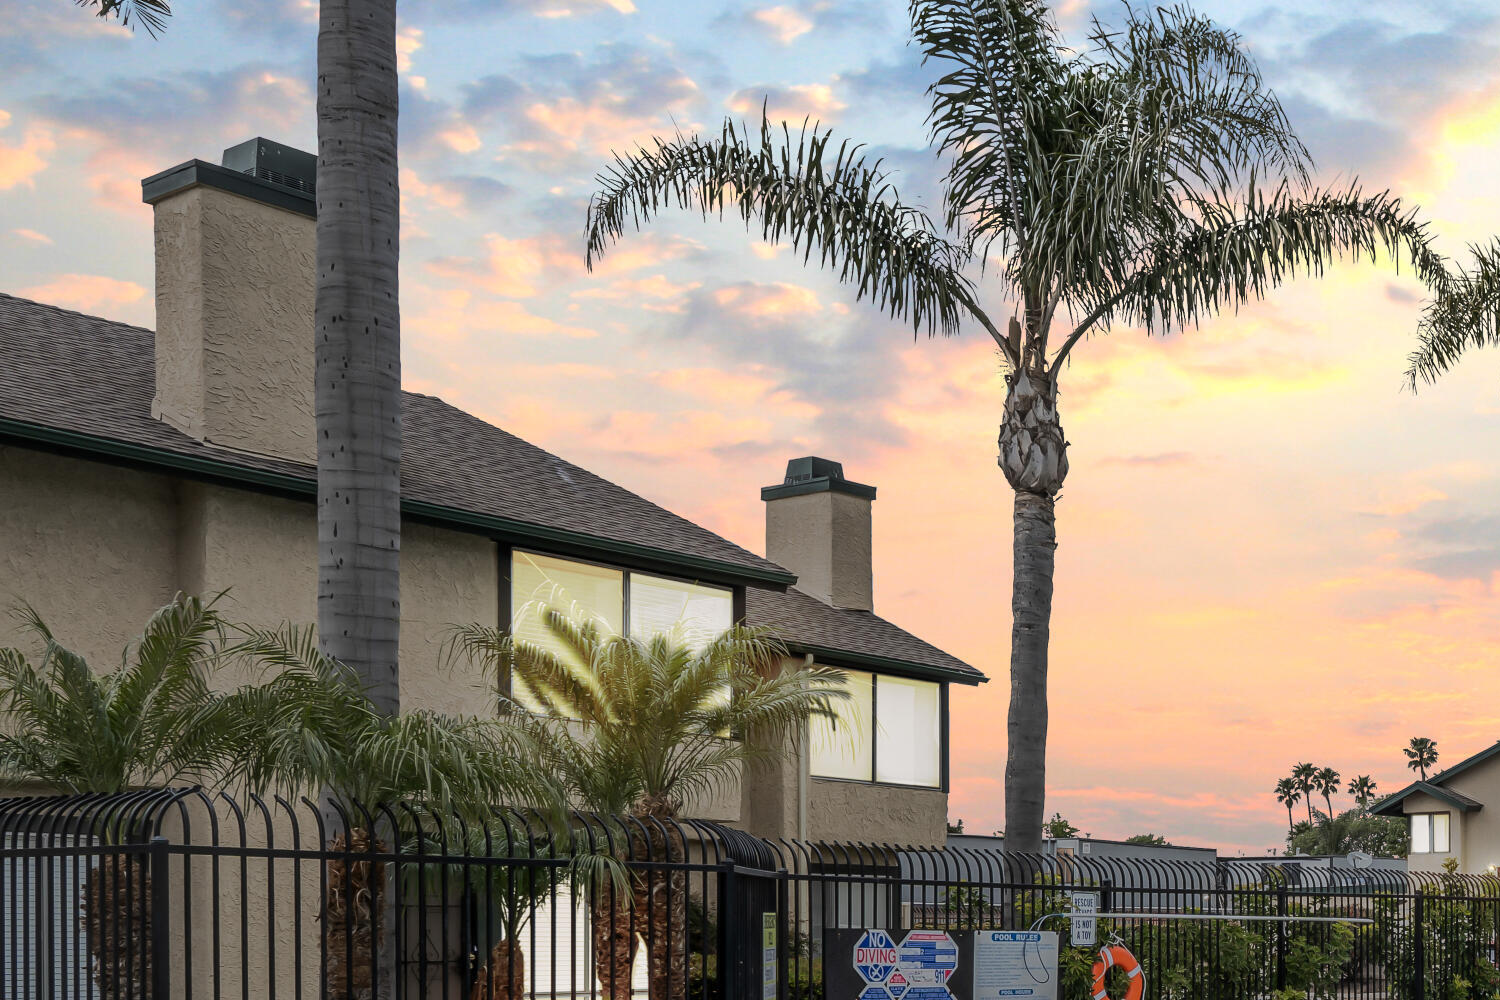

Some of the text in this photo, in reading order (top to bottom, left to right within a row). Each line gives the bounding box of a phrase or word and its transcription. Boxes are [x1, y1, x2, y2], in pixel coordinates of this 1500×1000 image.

[1075, 898, 1093, 907] RESCUE
[1075, 920, 1092, 929] IS NOT
[869, 931, 885, 947] NO
[1082, 931, 1091, 940] TOY
[857, 949, 896, 964] DIVING
[934, 970, 945, 983] 911
